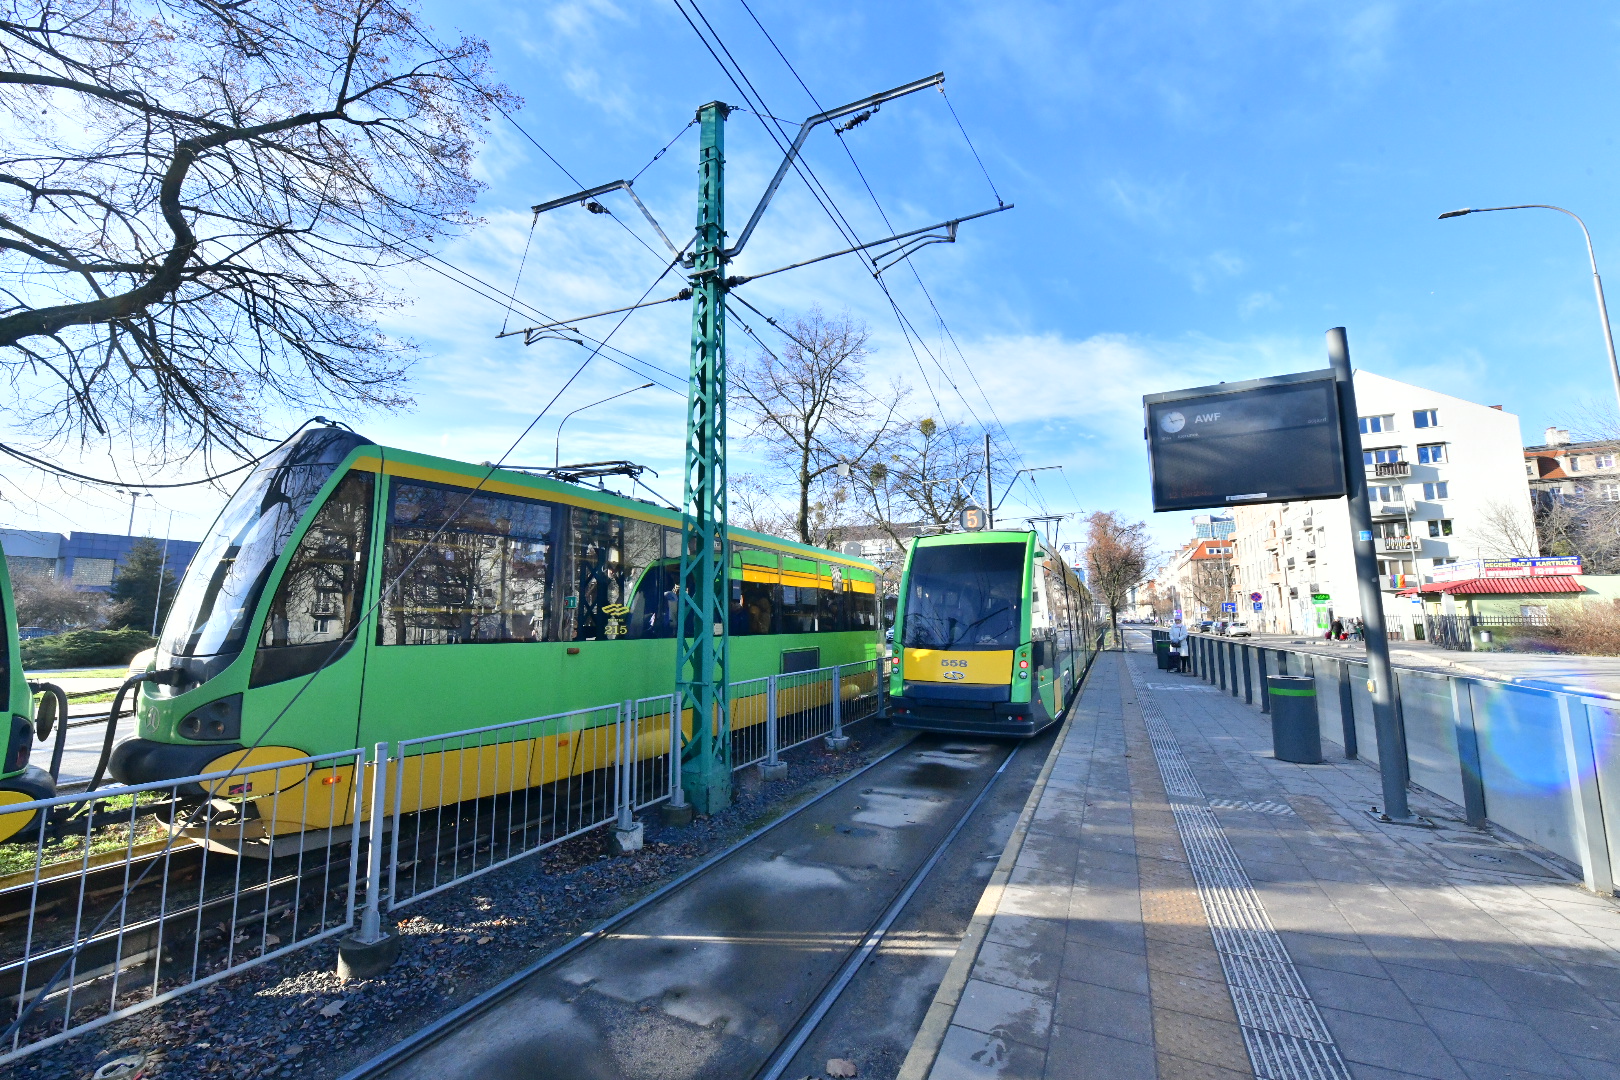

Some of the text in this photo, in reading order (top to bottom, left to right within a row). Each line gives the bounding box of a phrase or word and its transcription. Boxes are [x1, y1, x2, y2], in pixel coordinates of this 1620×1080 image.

[1194, 412, 1221, 424] AWF
[966, 509, 978, 528] 5
[604, 625, 628, 635] 215
[941, 659, 968, 667] 558
